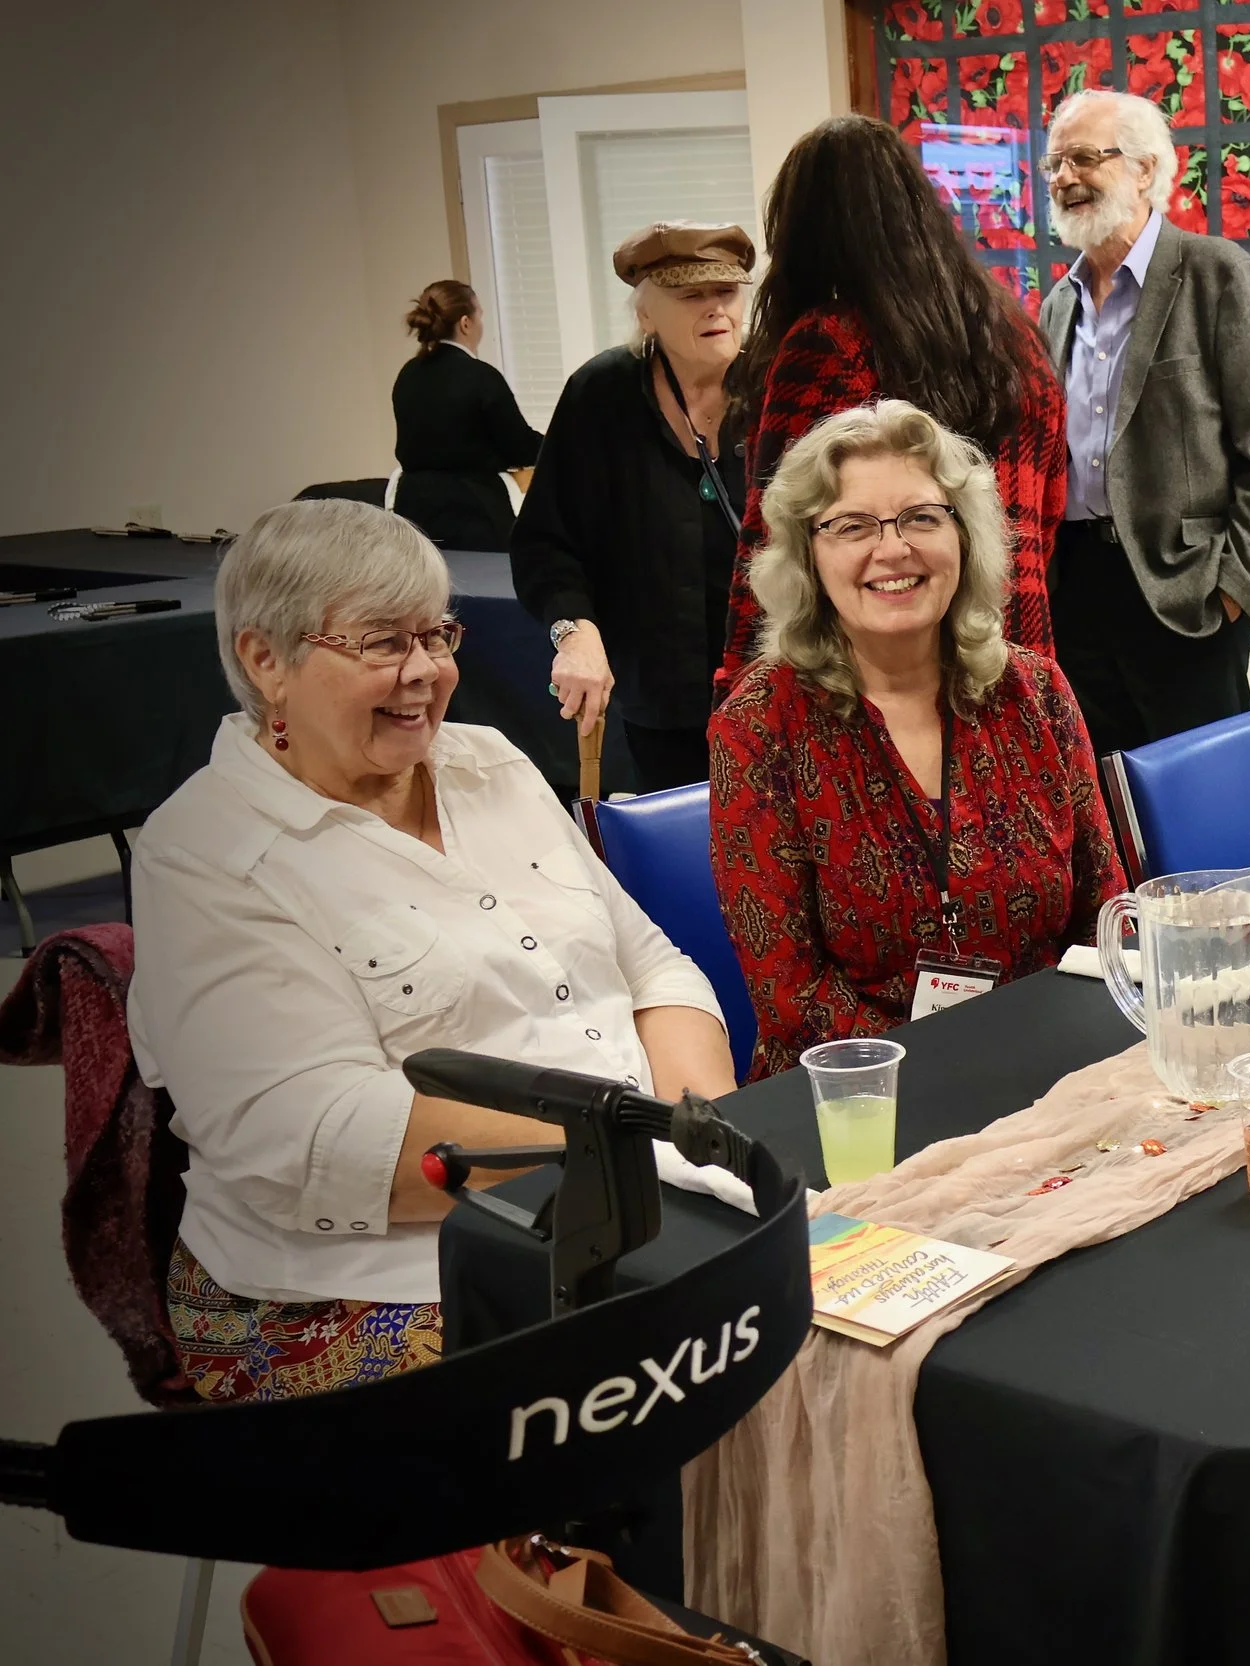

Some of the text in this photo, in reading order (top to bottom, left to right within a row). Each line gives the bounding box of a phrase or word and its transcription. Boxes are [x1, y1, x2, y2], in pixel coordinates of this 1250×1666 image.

[941, 981, 960, 992] YFC
[873, 1254, 956, 1304] has always
